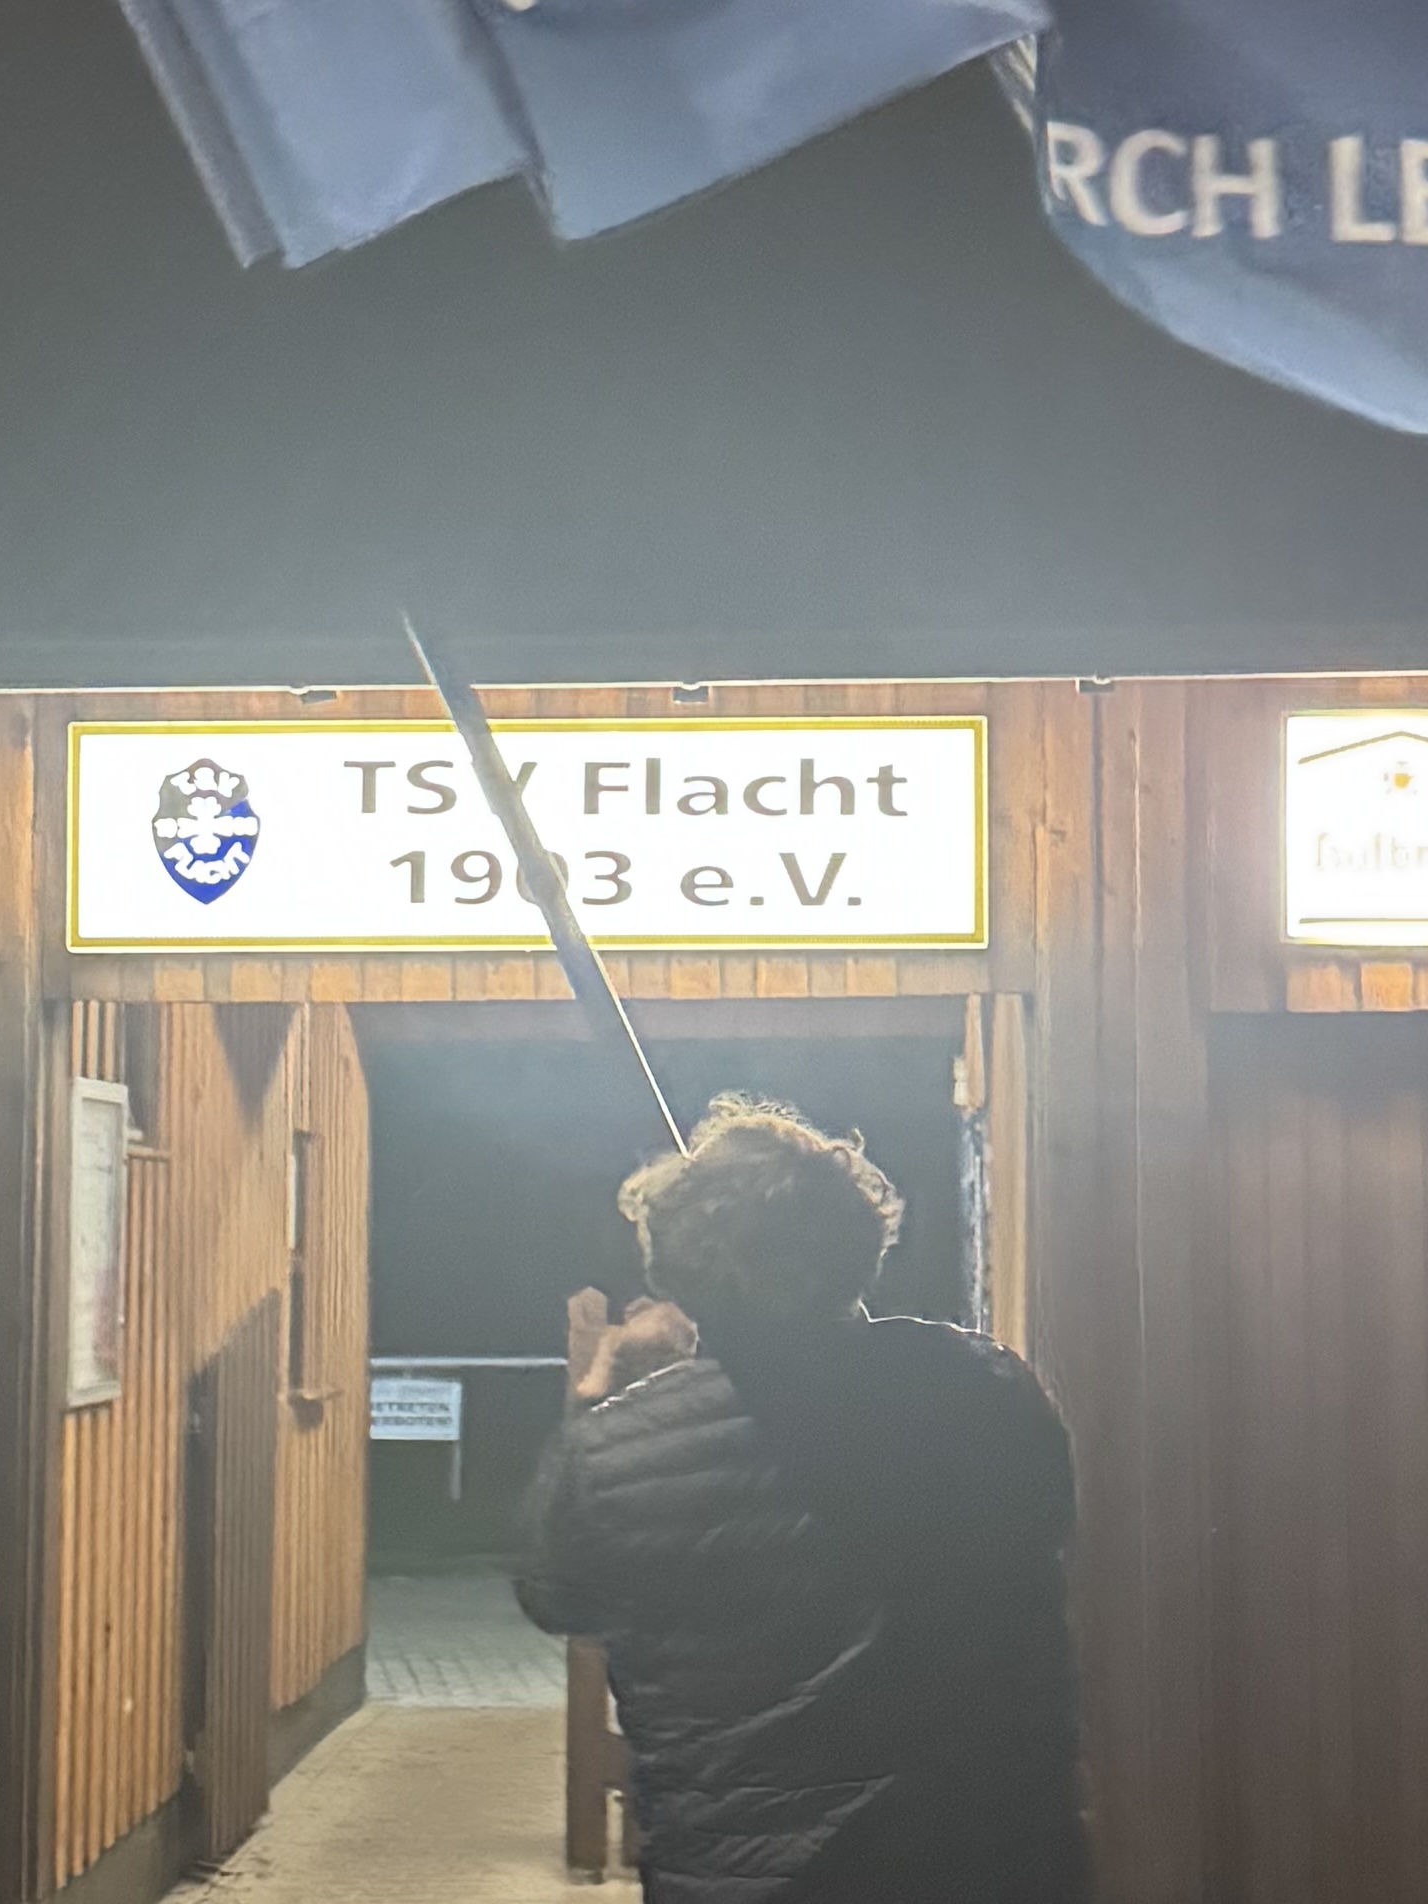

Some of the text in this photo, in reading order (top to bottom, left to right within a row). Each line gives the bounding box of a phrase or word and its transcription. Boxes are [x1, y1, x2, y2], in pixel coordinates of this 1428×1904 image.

[1046, 117, 1281, 240] RCH
[582, 756, 910, 817] Flacht
[388, 849, 864, 907] 1903 e.V.
